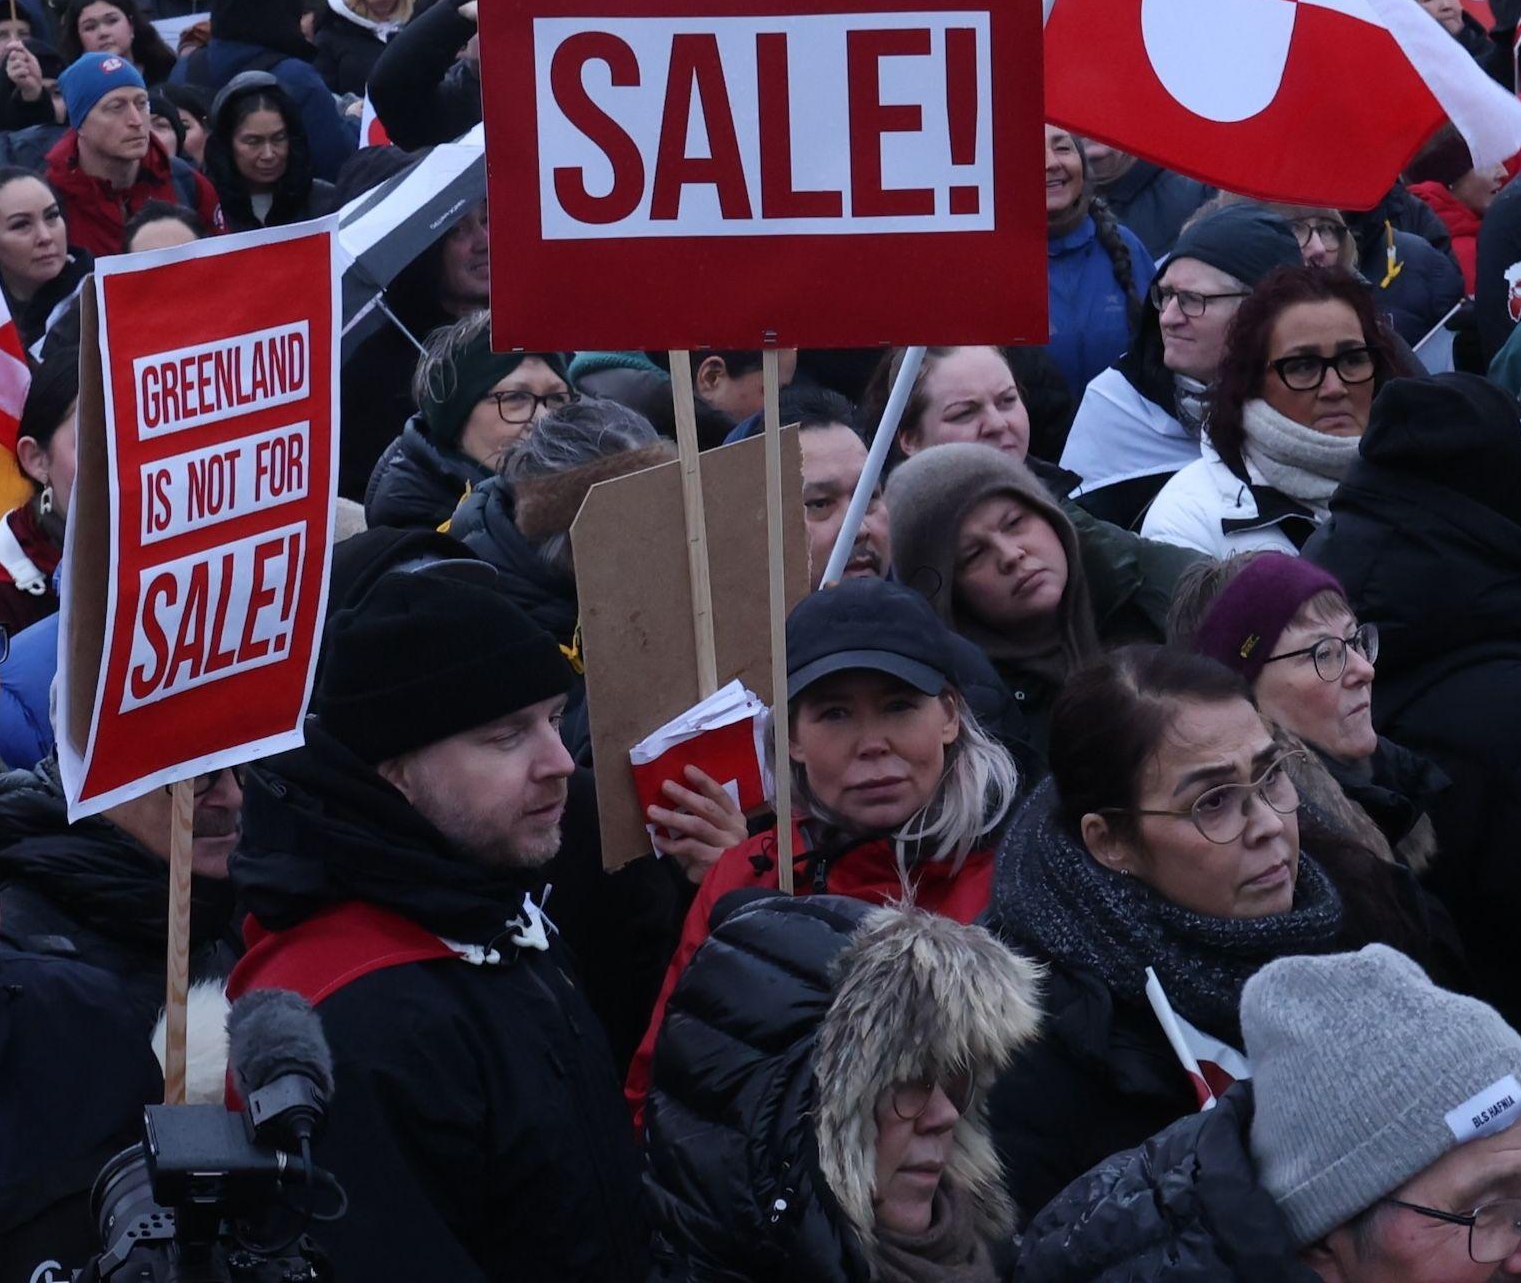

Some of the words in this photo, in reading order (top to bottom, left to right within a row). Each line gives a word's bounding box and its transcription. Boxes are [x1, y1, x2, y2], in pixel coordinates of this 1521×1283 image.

[550, 27, 980, 225] SALE!
[141, 331, 305, 429] GREENLAND
[146, 468, 173, 535] IS
[186, 449, 242, 519] NOT
[254, 431, 304, 503] FOR
[130, 532, 303, 701] SALE!
[1471, 1110, 1491, 1129] BLS
[1487, 1094, 1516, 1119] HAFNIA
